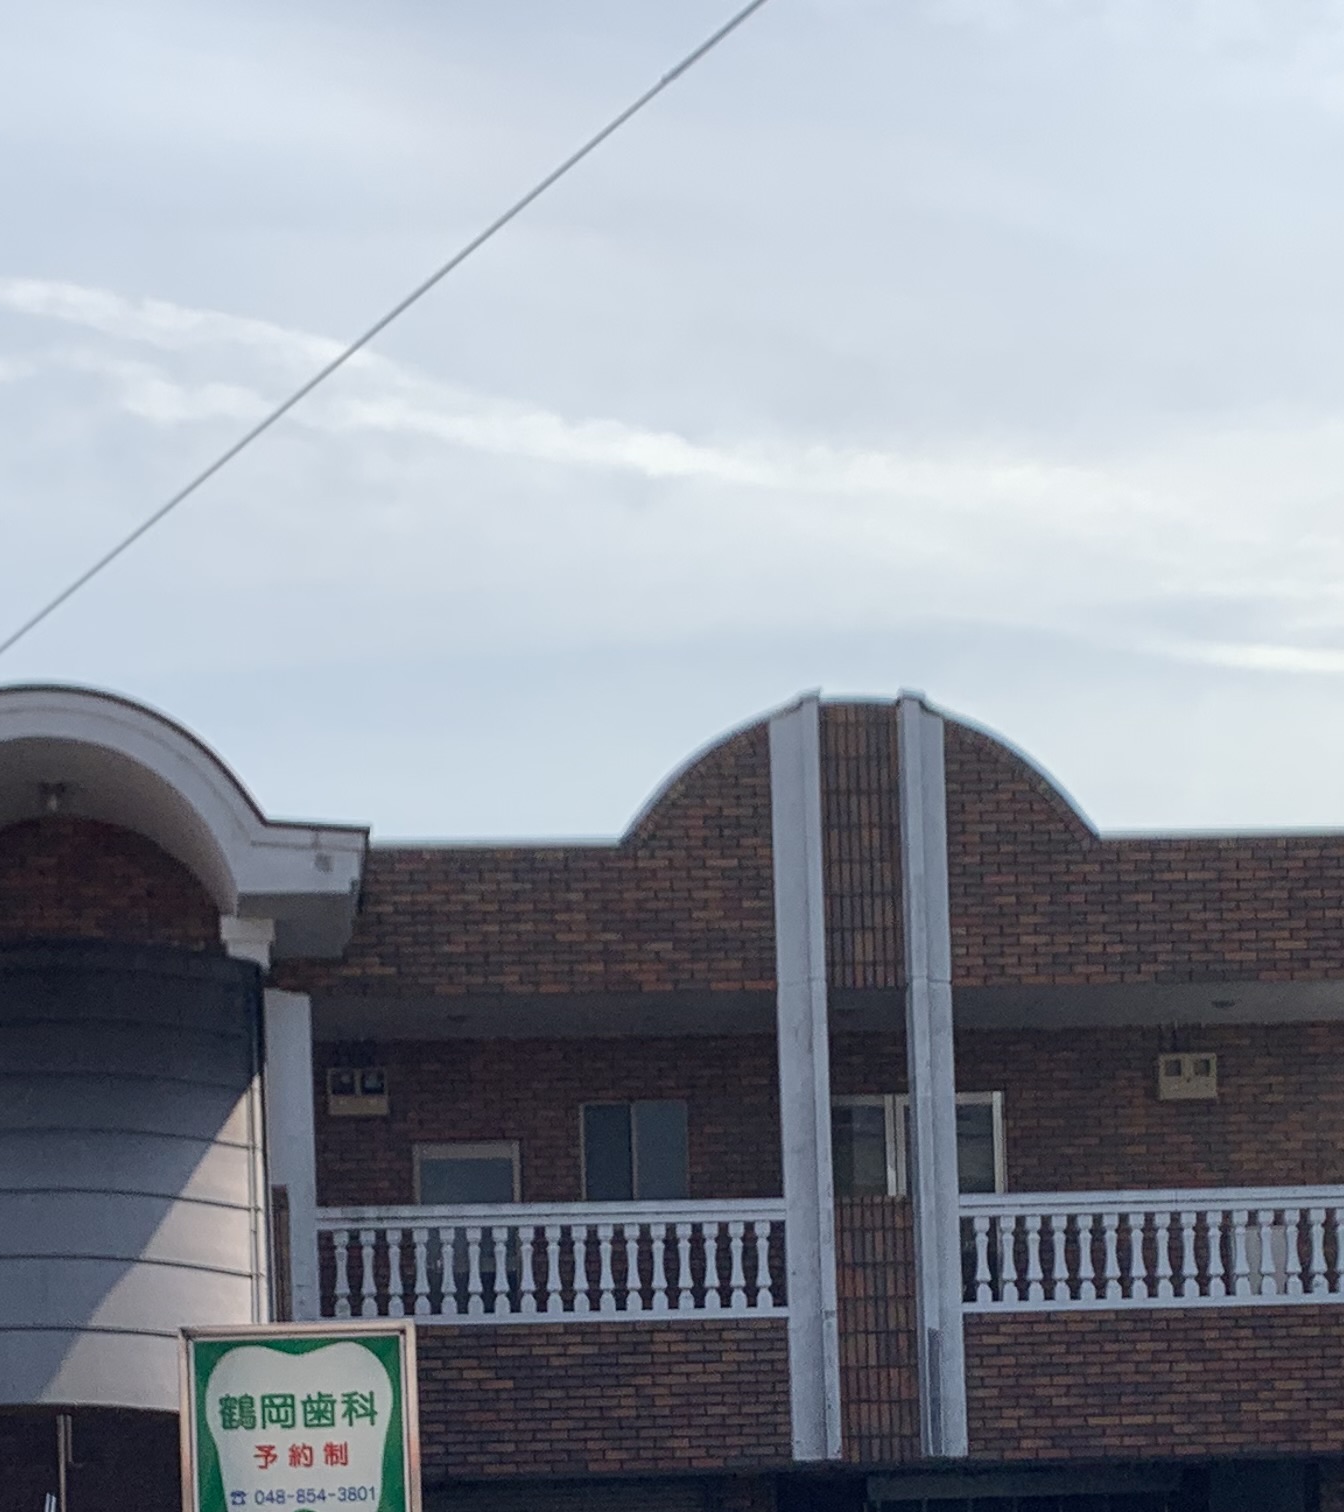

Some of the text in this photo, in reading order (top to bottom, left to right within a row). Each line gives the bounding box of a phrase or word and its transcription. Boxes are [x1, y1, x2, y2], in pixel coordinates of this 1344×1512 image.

[218, 1390, 378, 1430] 鶴岡歯科
[253, 1441, 349, 1469] 予約制
[255, 1485, 376, 1505] 048-854-3801
